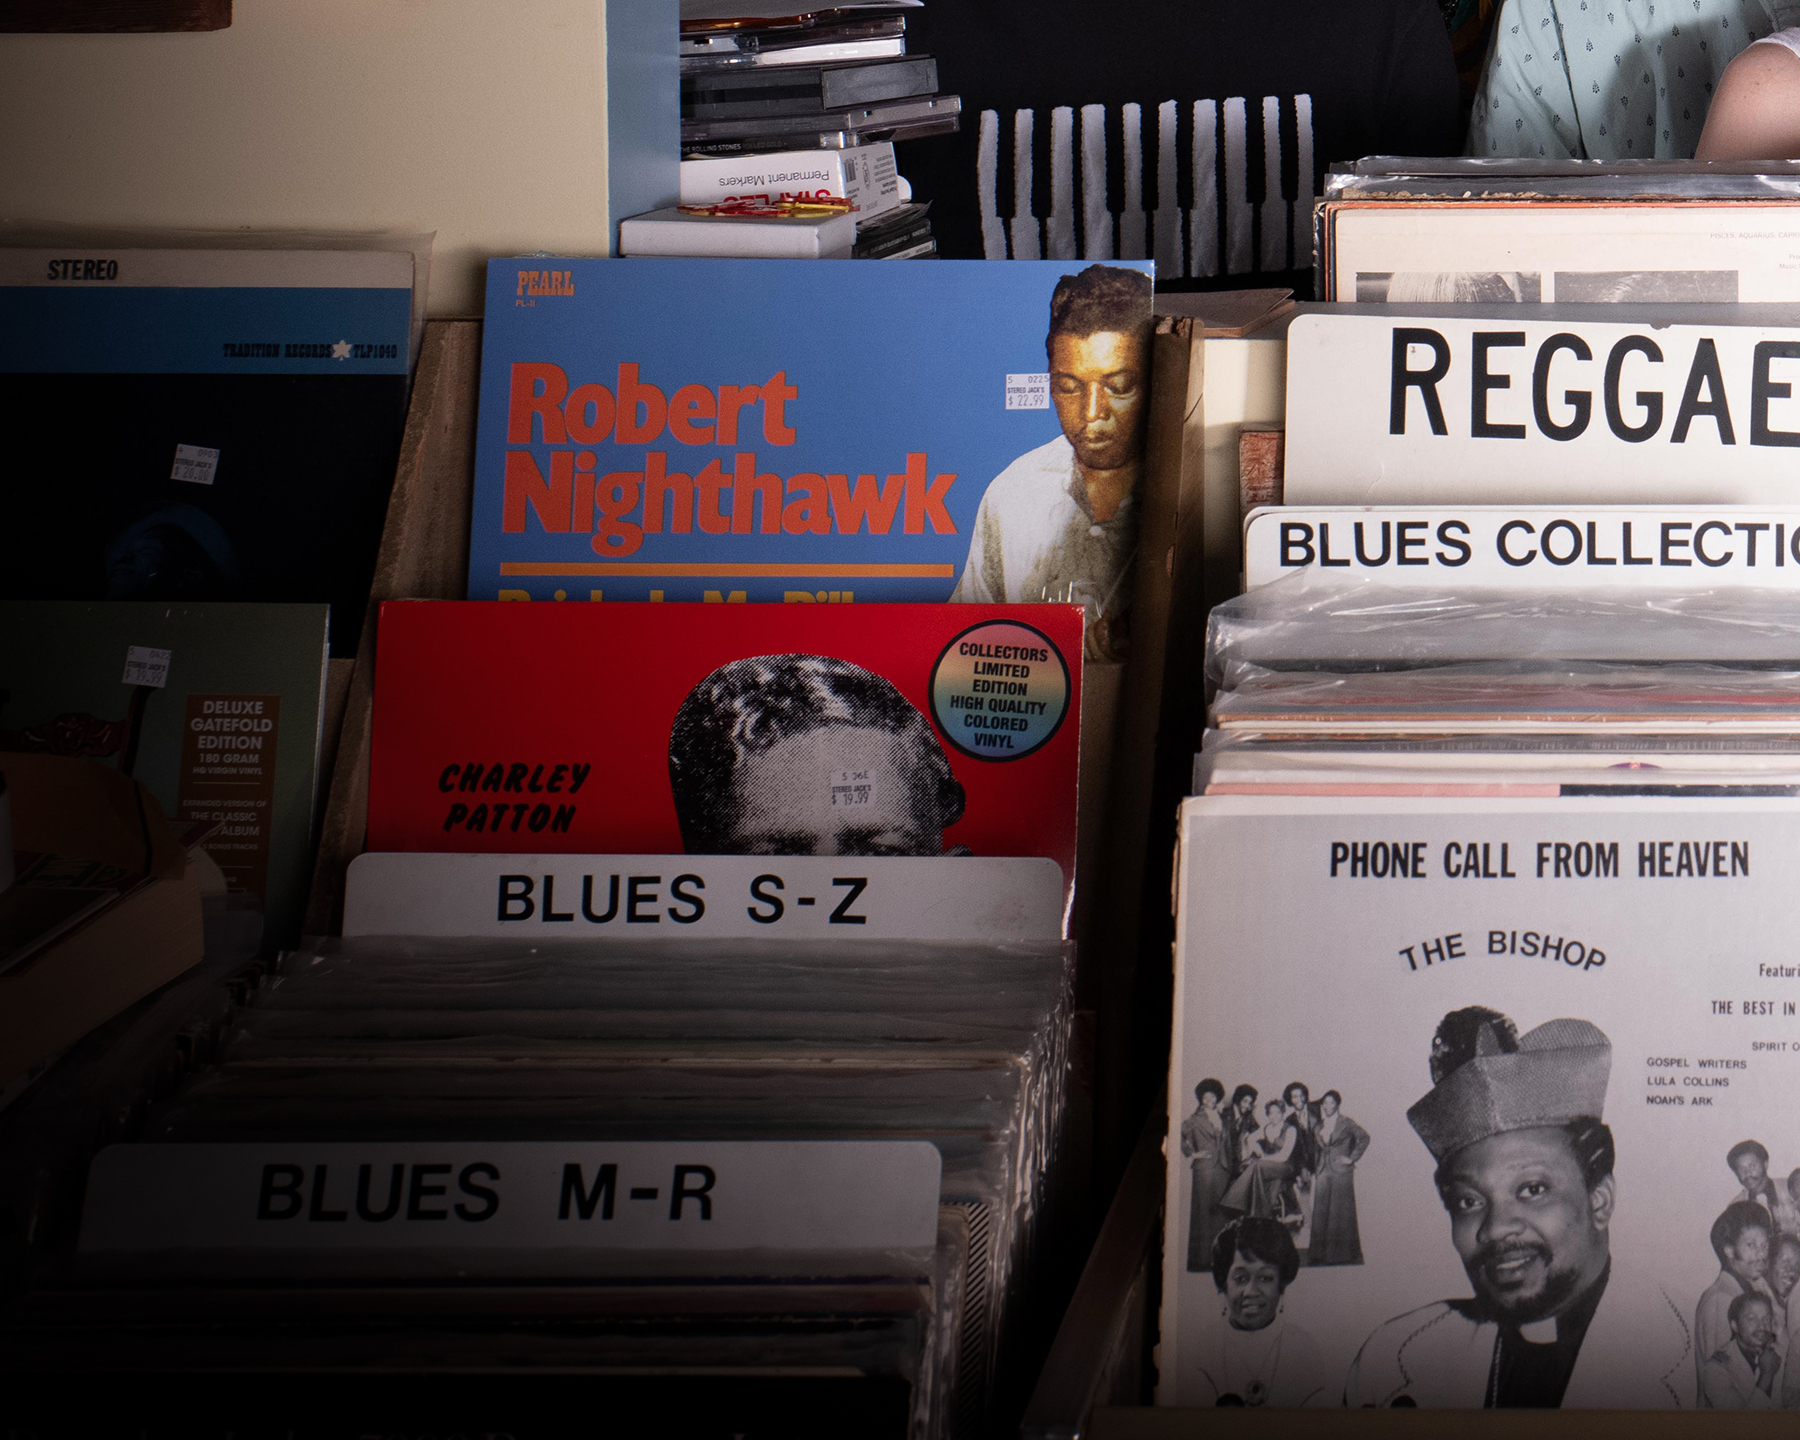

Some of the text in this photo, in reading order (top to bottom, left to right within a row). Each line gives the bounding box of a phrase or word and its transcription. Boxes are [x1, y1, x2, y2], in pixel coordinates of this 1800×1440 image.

[691, 143, 741, 152] ROLLING STONES
[718, 169, 830, 188] Permanent Markers
[47, 259, 118, 281] STEREO
[516, 270, 575, 296] PEARL
[222, 343, 281, 359] TRADITION
[284, 343, 333, 359] RECORDS
[1007, 386, 1045, 394] STEREO JACK'S
[506, 362, 798, 447] Robert
[1017, 394, 1044, 406] 22.99
[501, 450, 959, 558] Nighthawk
[1278, 519, 1473, 568] BLUES
[959, 642, 1049, 663] COLLECTORS
[973, 661, 1030, 679] LIMITED
[972, 679, 1028, 696] EDITION
[202, 700, 264, 715] DELUXE
[950, 695, 1047, 716] HIGH QUALITY
[190, 717, 273, 733] GATEFOLD
[963, 714, 1029, 732] COLORED
[197, 735, 263, 750] EDITION
[974, 732, 1015, 749] VINYL
[199, 753, 260, 764] 180 GRAM
[192, 766, 263, 775] HQ VIRGIN VINYL
[438, 762, 591, 795] CHARLEY
[256, 800, 268, 808] OF
[843, 791, 869, 806] 19.99
[190, 812, 258, 822] THE CLASSIC
[442, 802, 577, 834] PATTON
[220, 826, 260, 836] ALBUM
[233, 843, 258, 851] TRACKS
[1329, 840, 1751, 879] PHONE CALL FROM HEAVEN
[497, 873, 870, 925] BLUES S-Z
[1399, 929, 1608, 973] THE BISHOP
[1711, 1000, 1734, 1015] THE
[1742, 1001, 1775, 1016] BEST
[1783, 1001, 1796, 1016] IN
[1751, 1041, 1787, 1052] SPIRIT
[1646, 1057, 1747, 1070] GOSPEL WRITERS
[1647, 1076, 1730, 1087] LULA COLLINS
[1646, 1095, 1713, 1106] NOAH'S ARK
[256, 1161, 718, 1223] BLUES M-R
